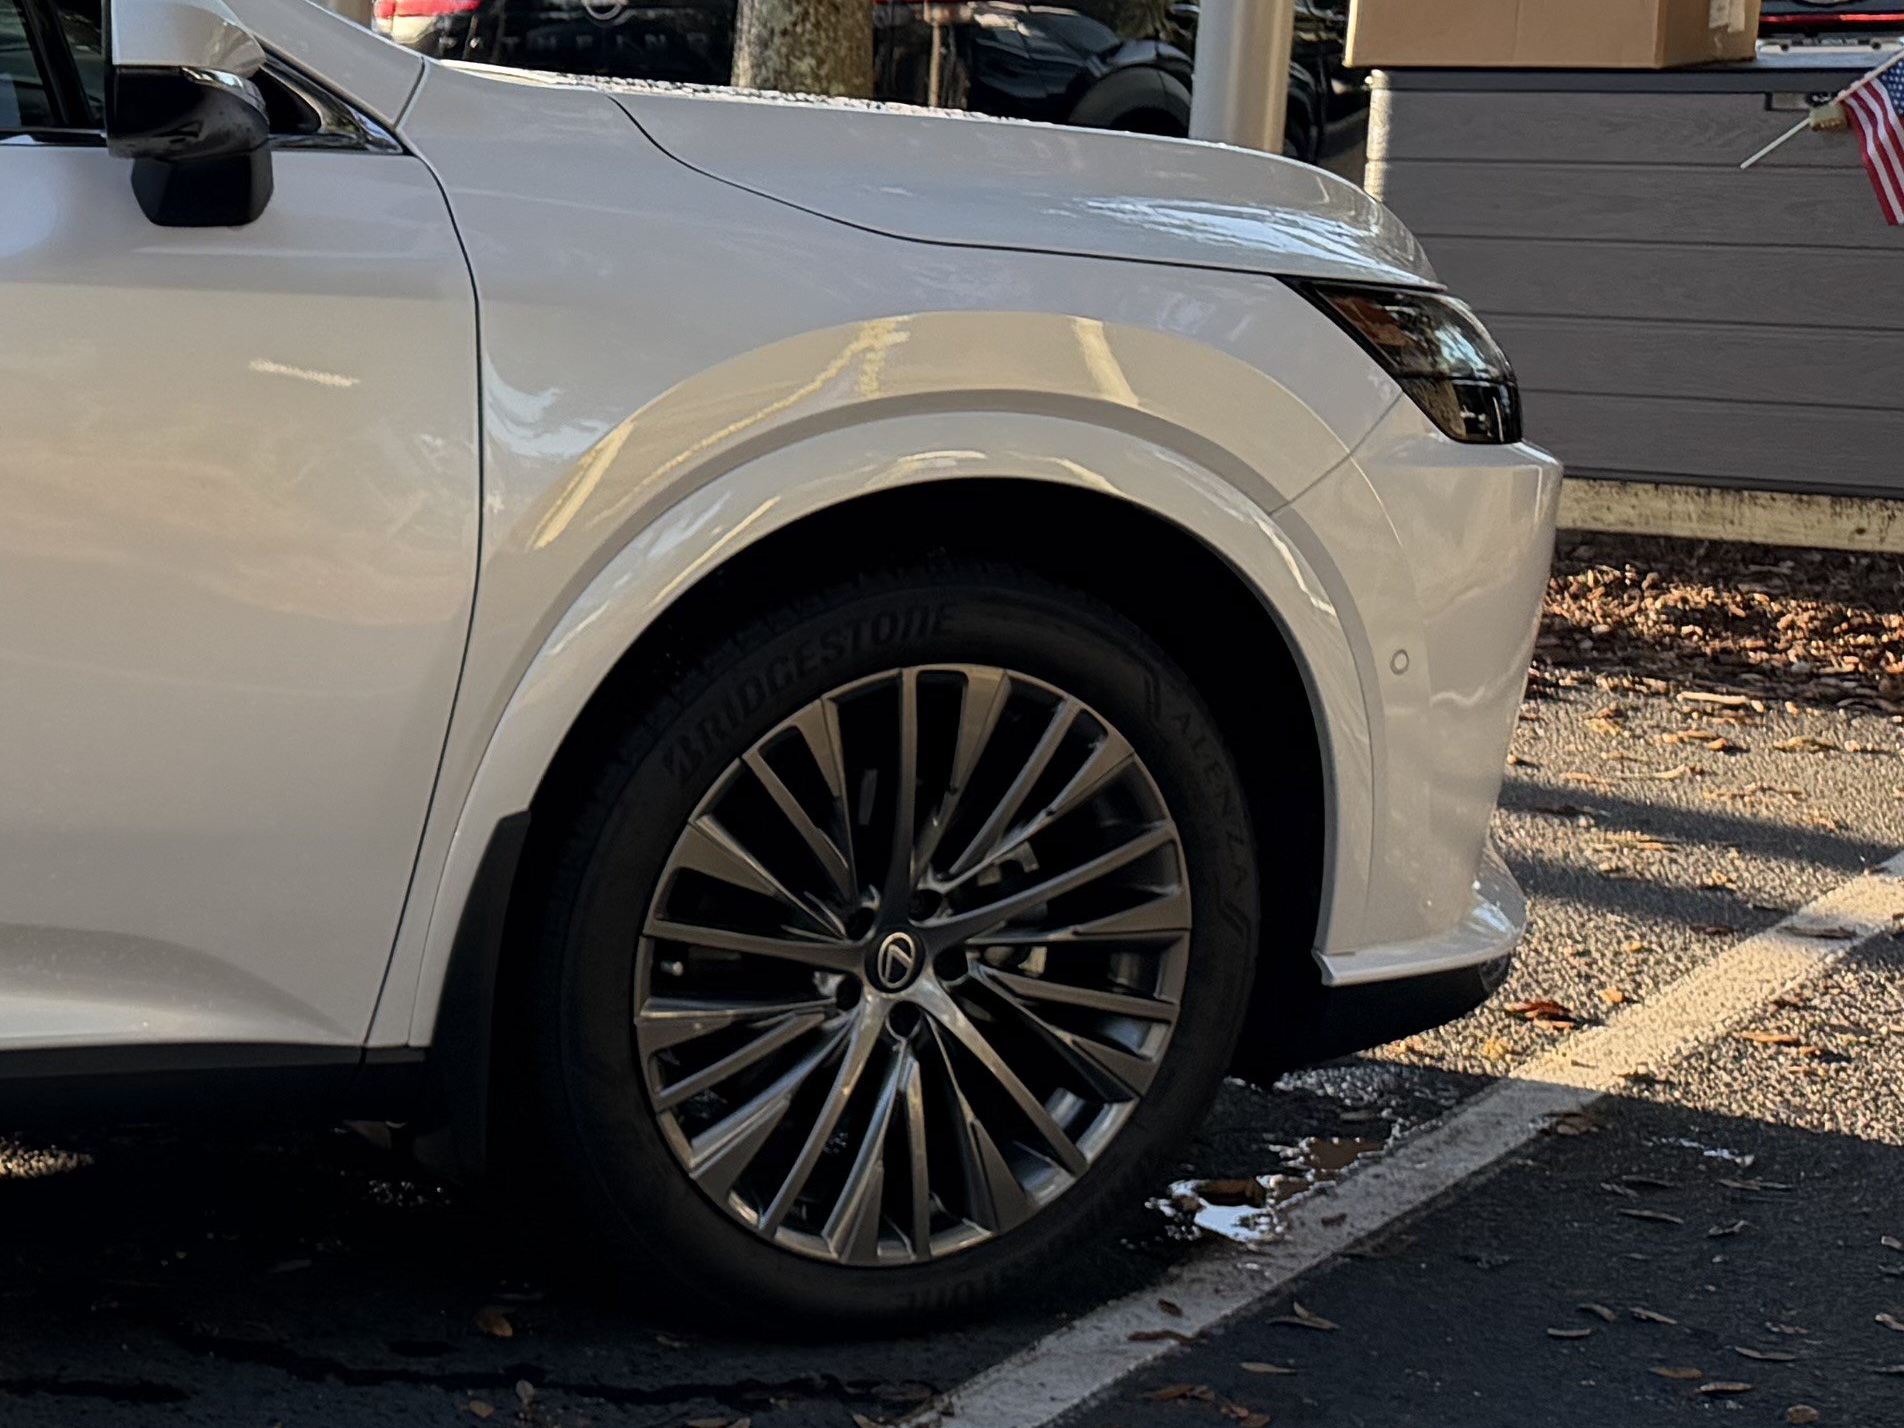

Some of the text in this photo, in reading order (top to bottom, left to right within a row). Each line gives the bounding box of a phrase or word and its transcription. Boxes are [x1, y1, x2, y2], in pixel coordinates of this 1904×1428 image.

[438, 30, 714, 57] PATHFIND
[662, 600, 958, 784] BRIDGESTONE
[1172, 713, 1248, 889] ALENZA
